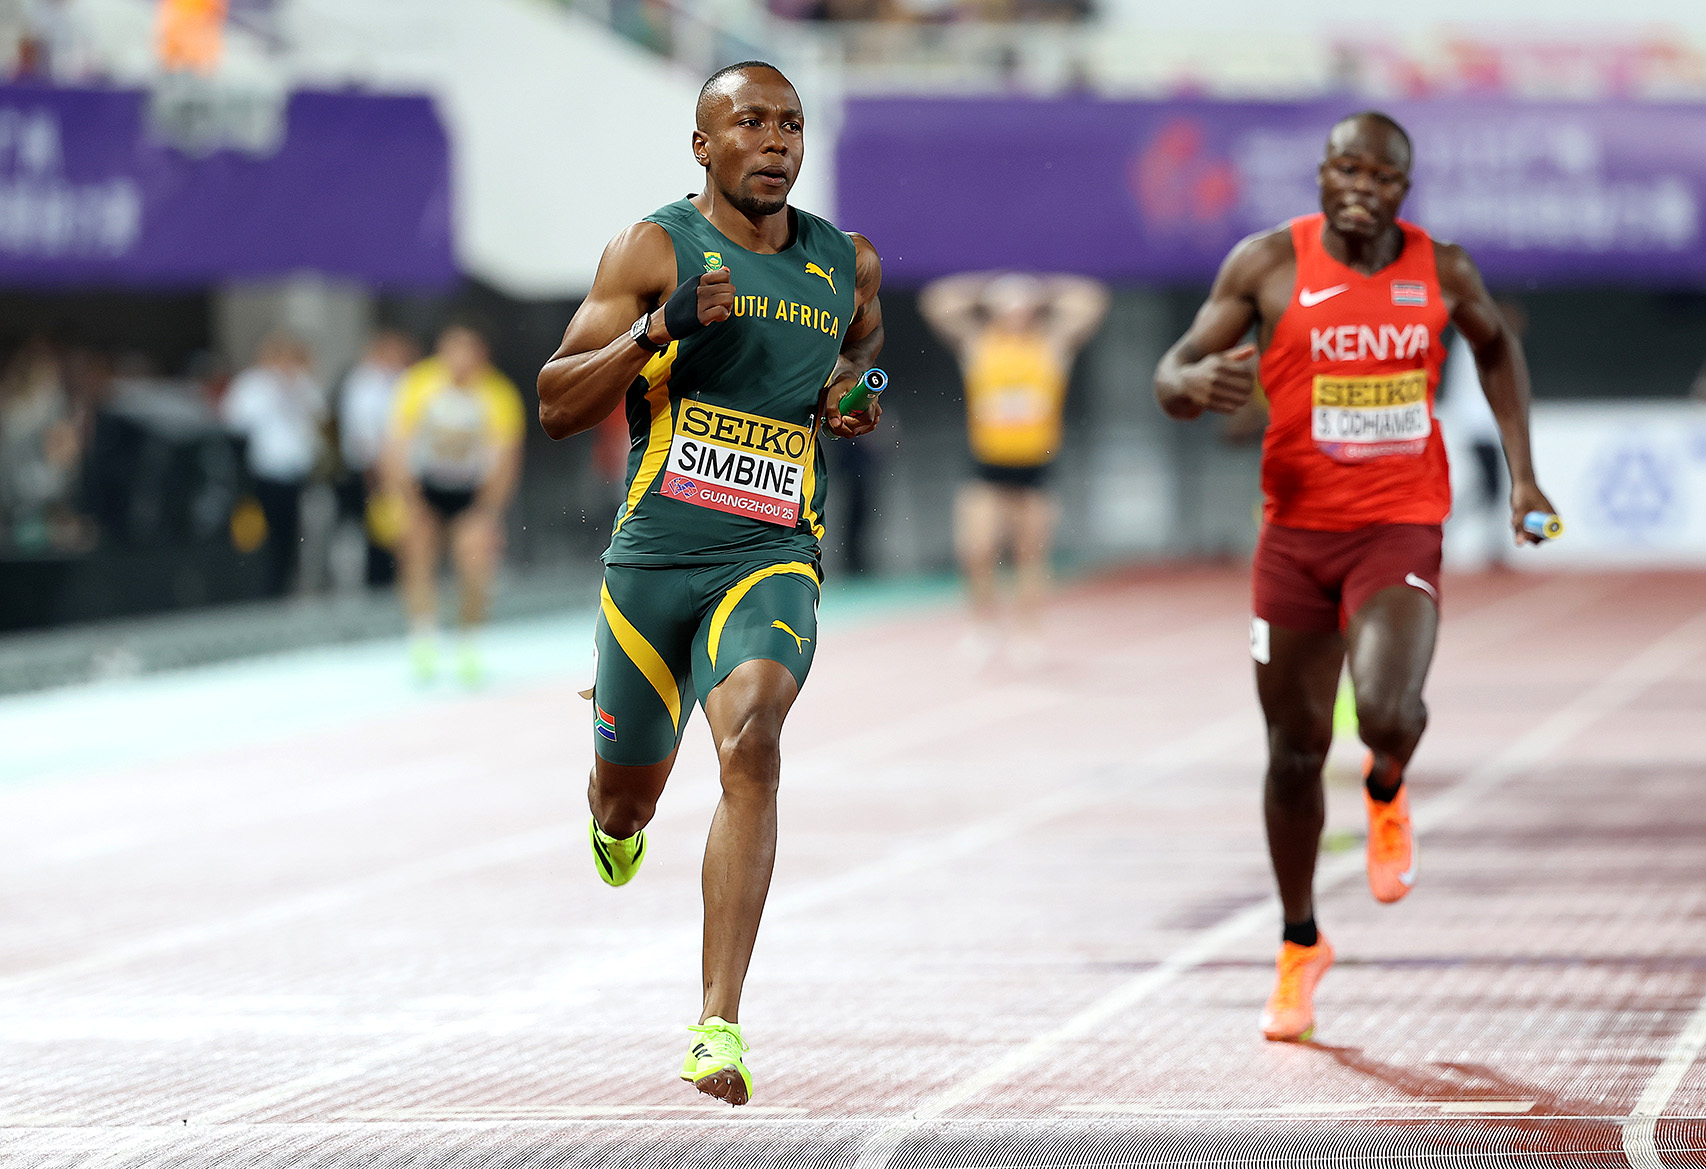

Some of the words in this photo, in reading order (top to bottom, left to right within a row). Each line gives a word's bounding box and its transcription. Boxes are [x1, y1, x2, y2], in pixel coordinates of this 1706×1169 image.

[734, 295, 768, 318] UTH
[775, 299, 839, 340] AFRICA
[1310, 323, 1430, 363] KENYA
[872, 376, 879, 385] 6
[1318, 376, 1424, 407] SEIKO
[682, 406, 806, 459] SEIKO
[678, 441, 798, 497] SIMBINE
[699, 488, 780, 517] GUANGZHOU
[781, 507, 795, 520] 25
